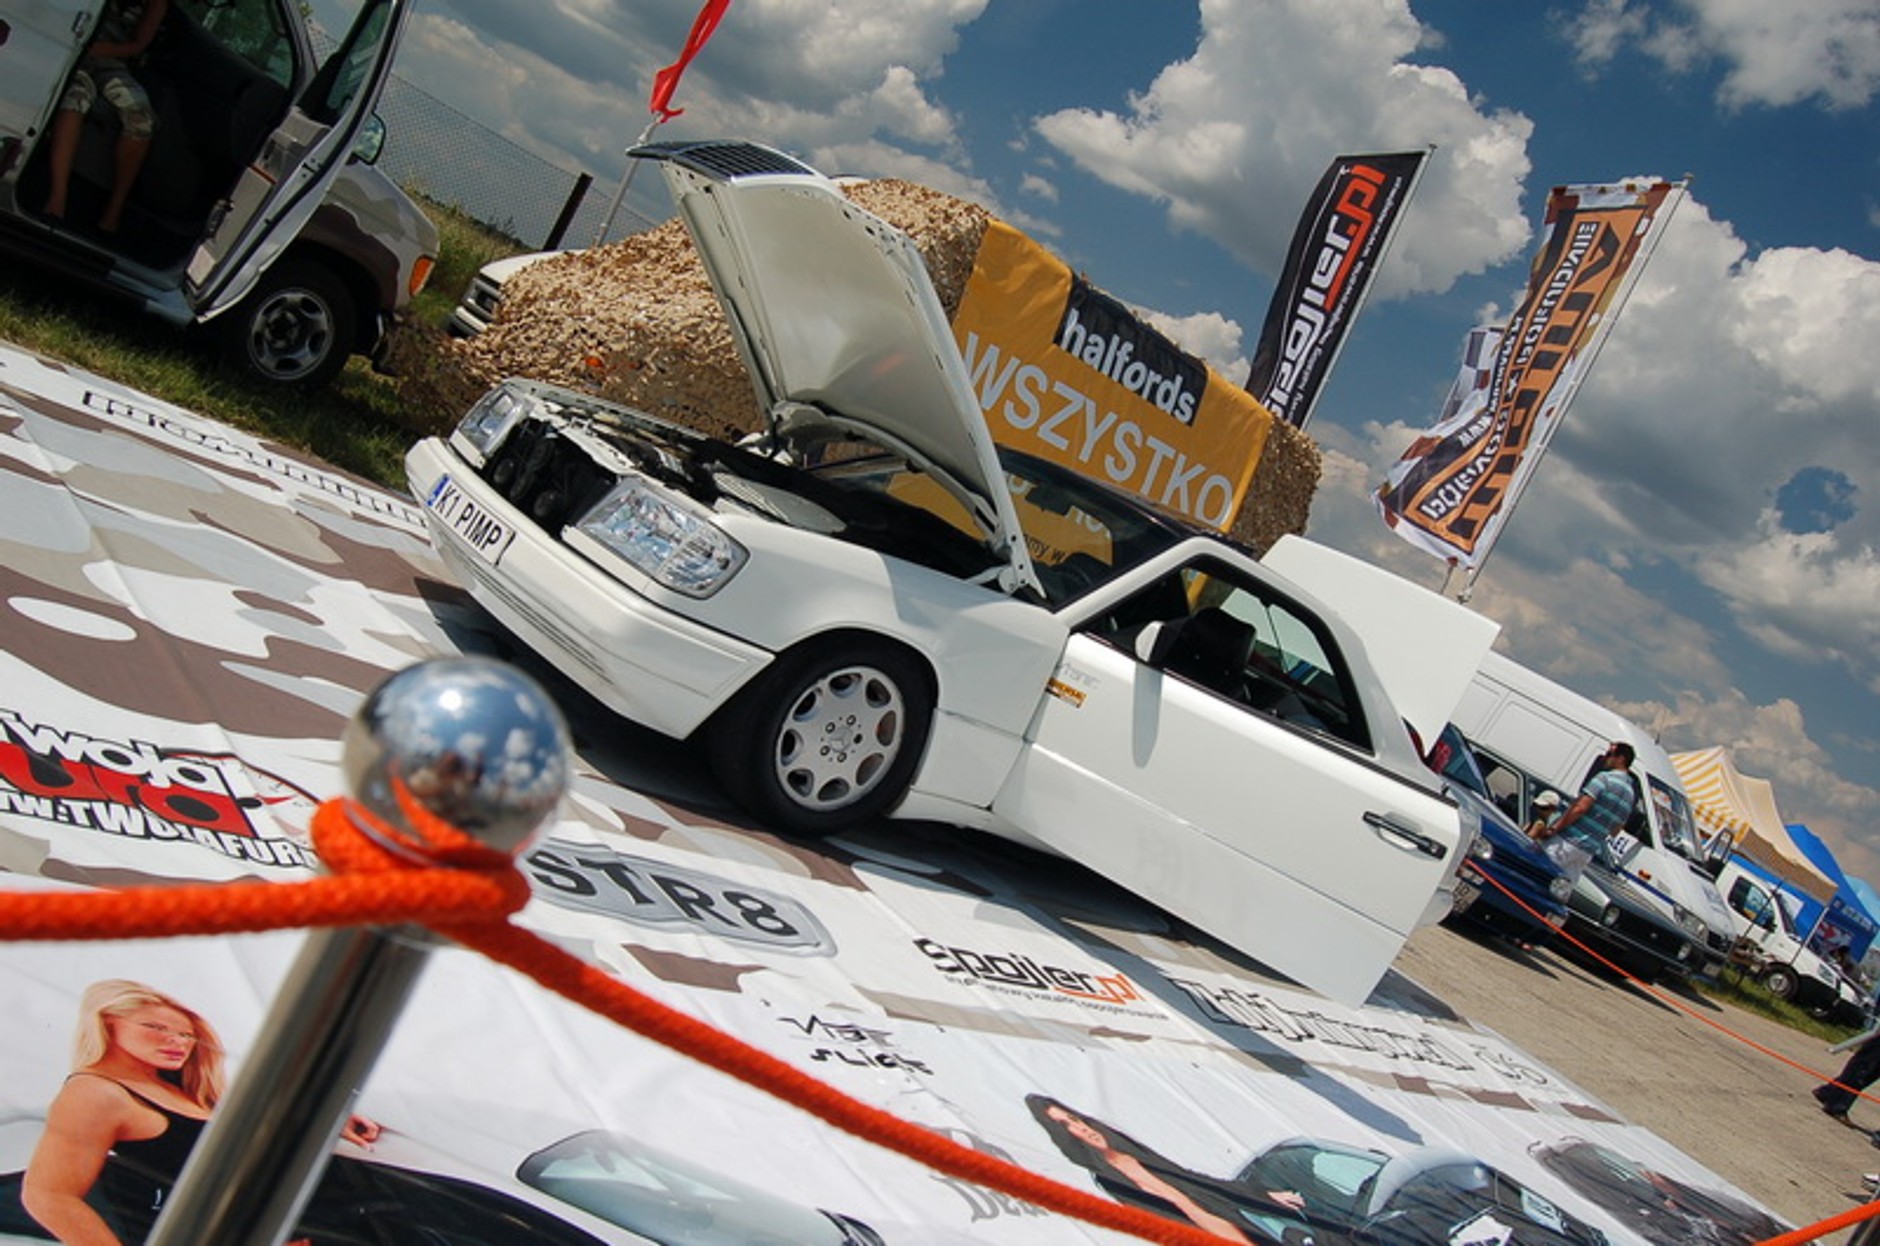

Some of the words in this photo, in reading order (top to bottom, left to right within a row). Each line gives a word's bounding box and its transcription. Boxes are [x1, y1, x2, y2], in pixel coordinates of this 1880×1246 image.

[1060, 307, 1197, 425] halfords
[963, 331, 1233, 529] WSZYSTKO
[435, 484, 461, 519] K1
[453, 501, 502, 552] PIMP
[526, 849, 800, 936] STR8
